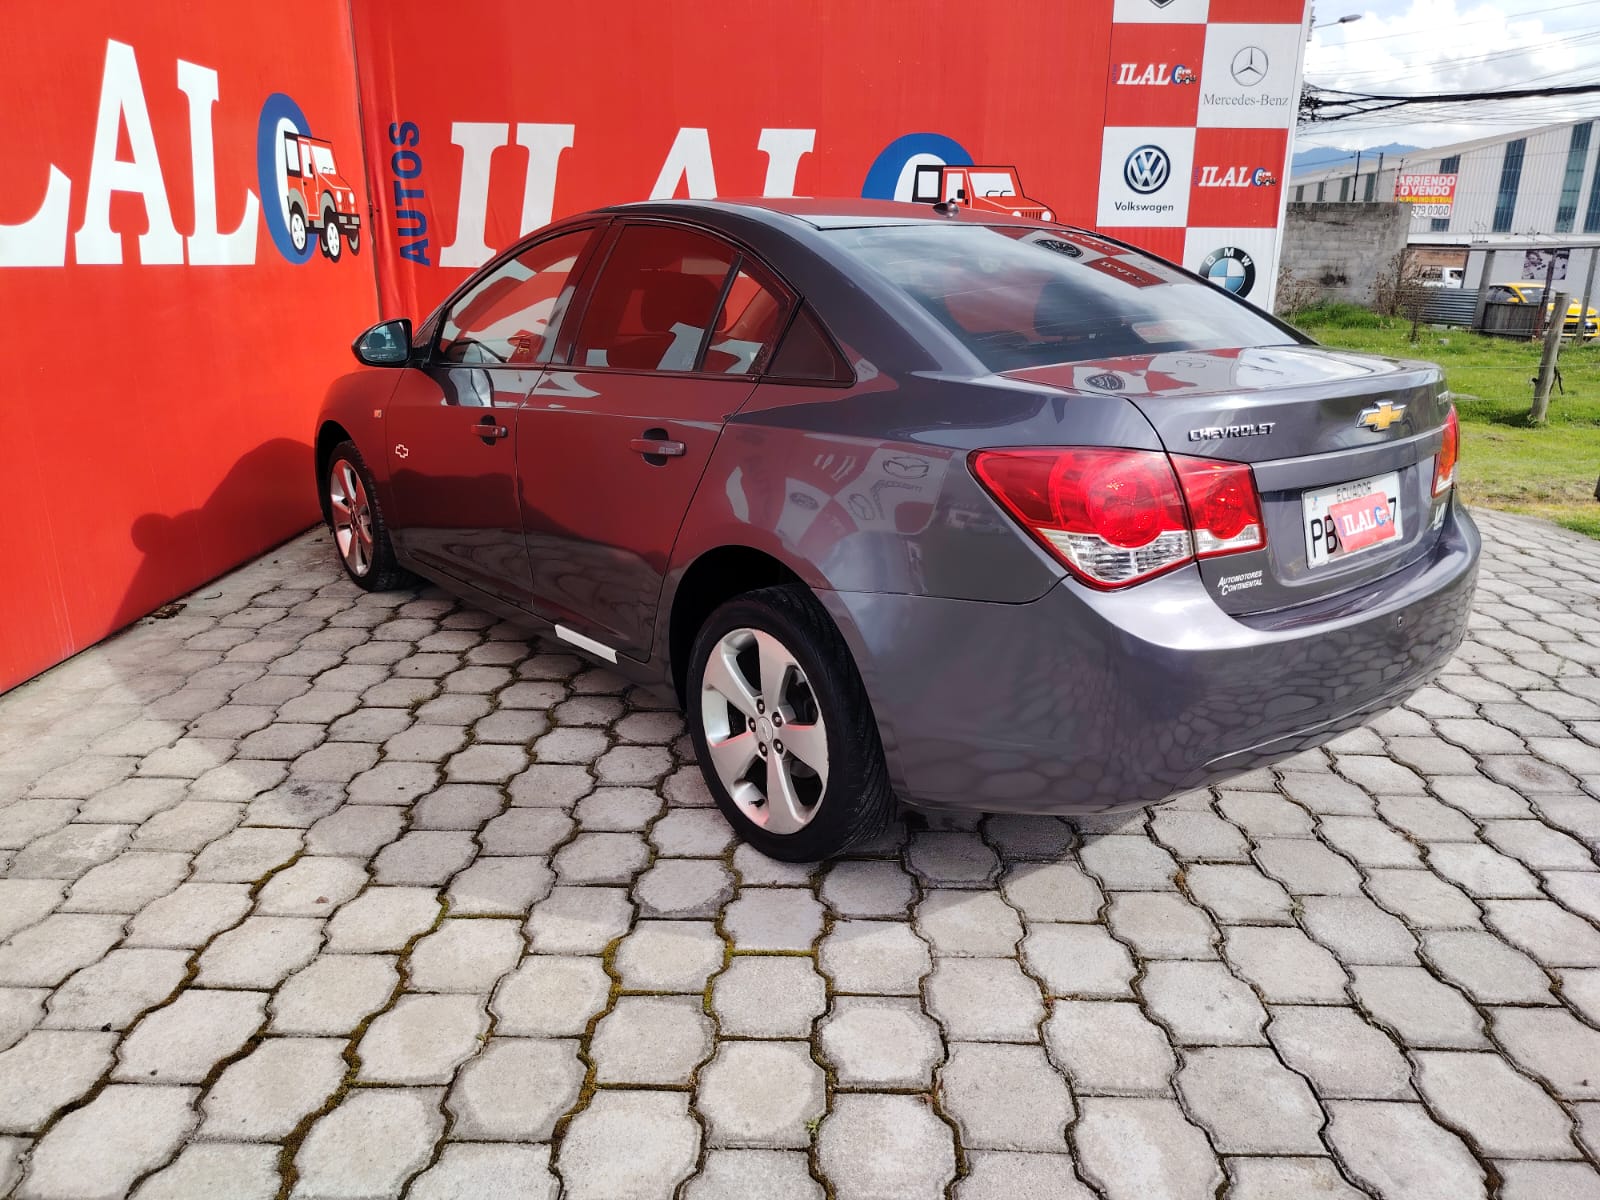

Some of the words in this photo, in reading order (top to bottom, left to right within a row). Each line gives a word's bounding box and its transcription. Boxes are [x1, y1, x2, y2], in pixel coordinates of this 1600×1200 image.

[1203, 93, 1289, 106] Mercedes-Benz
[1400, 175, 1456, 186] ARRIENDO
[391, 121, 431, 267] AUTOS
[1401, 186, 1409, 195] O
[1411, 186, 1449, 195] VENDO
[1115, 201, 1174, 213] Volkswagen
[1205, 247, 1253, 267] BMW
[1188, 422, 1276, 441] CHEVROLET
[1336, 481, 1371, 502] ECUADOR
[1217, 570, 1263, 588] AUTOMOTORES
[1221, 579, 1263, 596] CONTINENTAL
